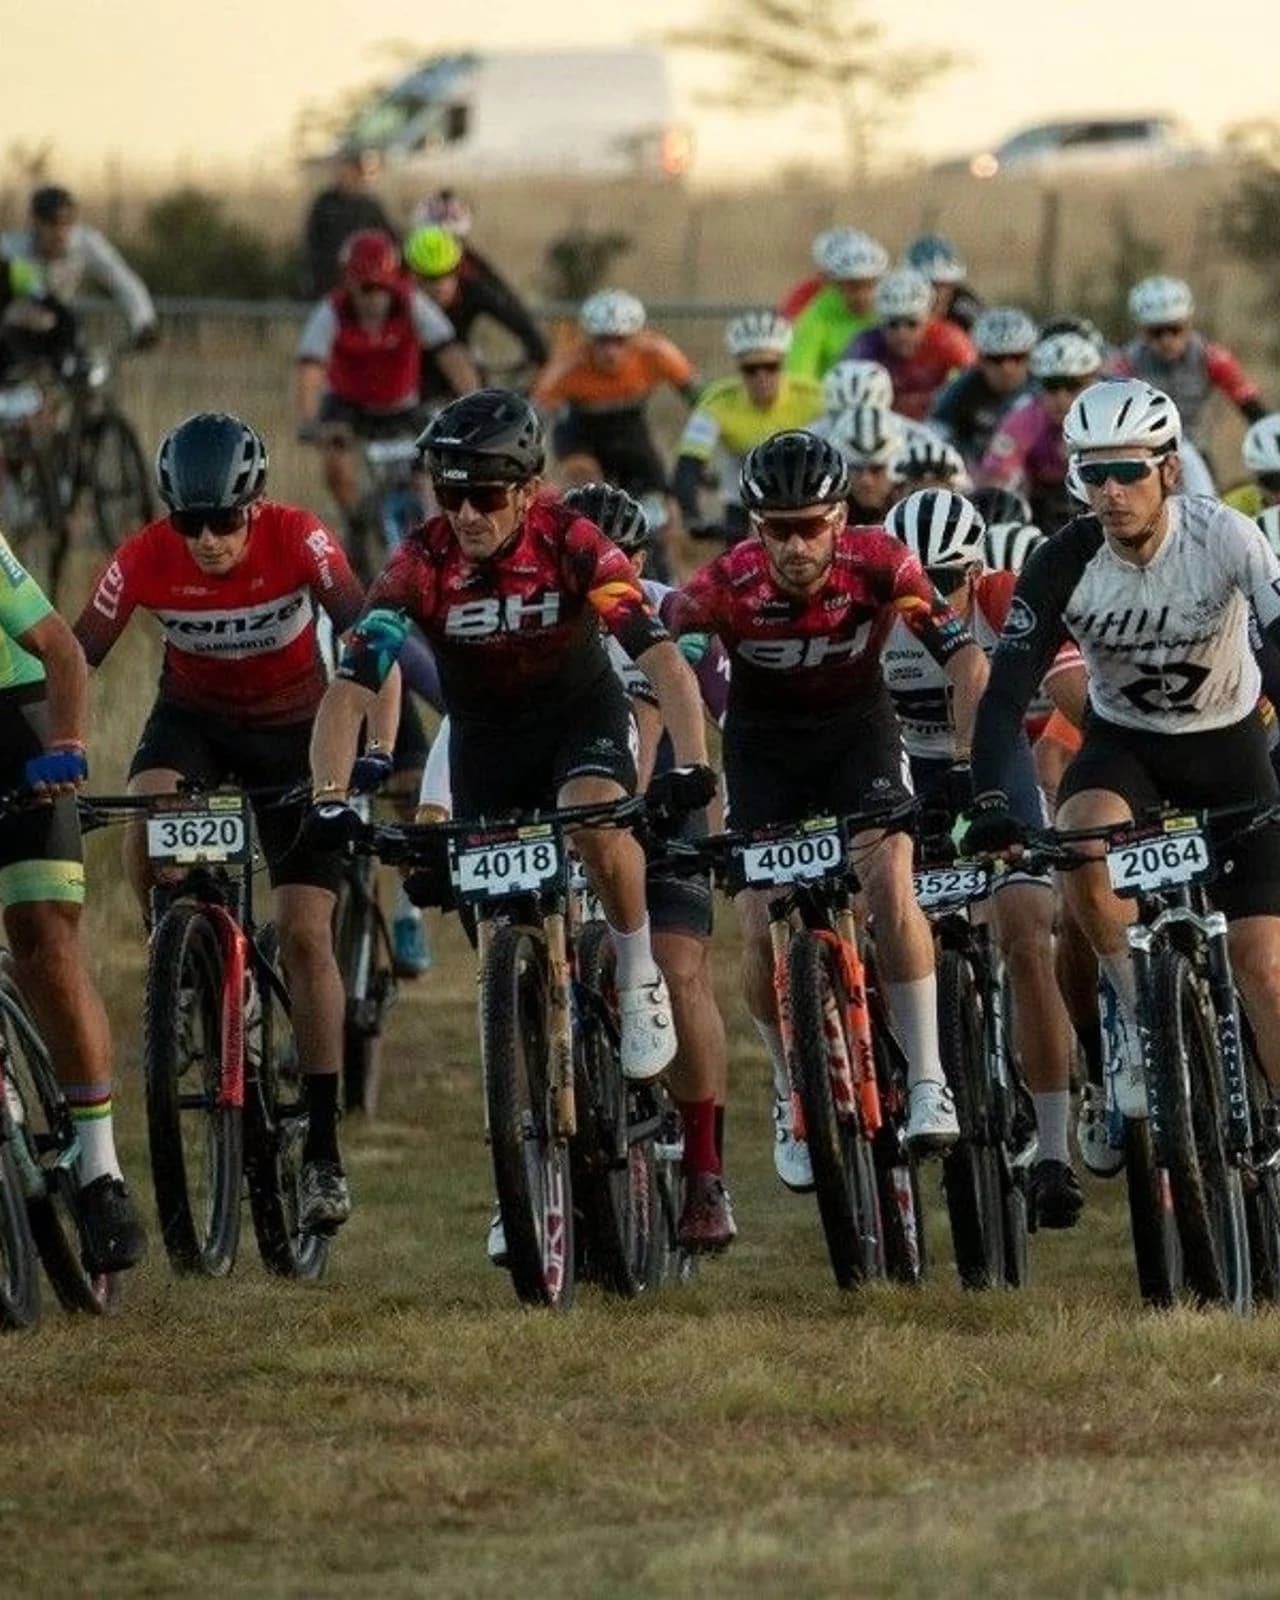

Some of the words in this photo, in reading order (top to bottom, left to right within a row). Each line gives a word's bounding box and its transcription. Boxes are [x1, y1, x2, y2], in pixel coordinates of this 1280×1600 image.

[446, 592, 560, 636] BH
[737, 620, 874, 669] BH
[161, 819, 238, 848] 3620
[473, 844, 551, 881] 4018
[758, 837, 834, 871] 4000
[1121, 838, 1202, 878] 2064
